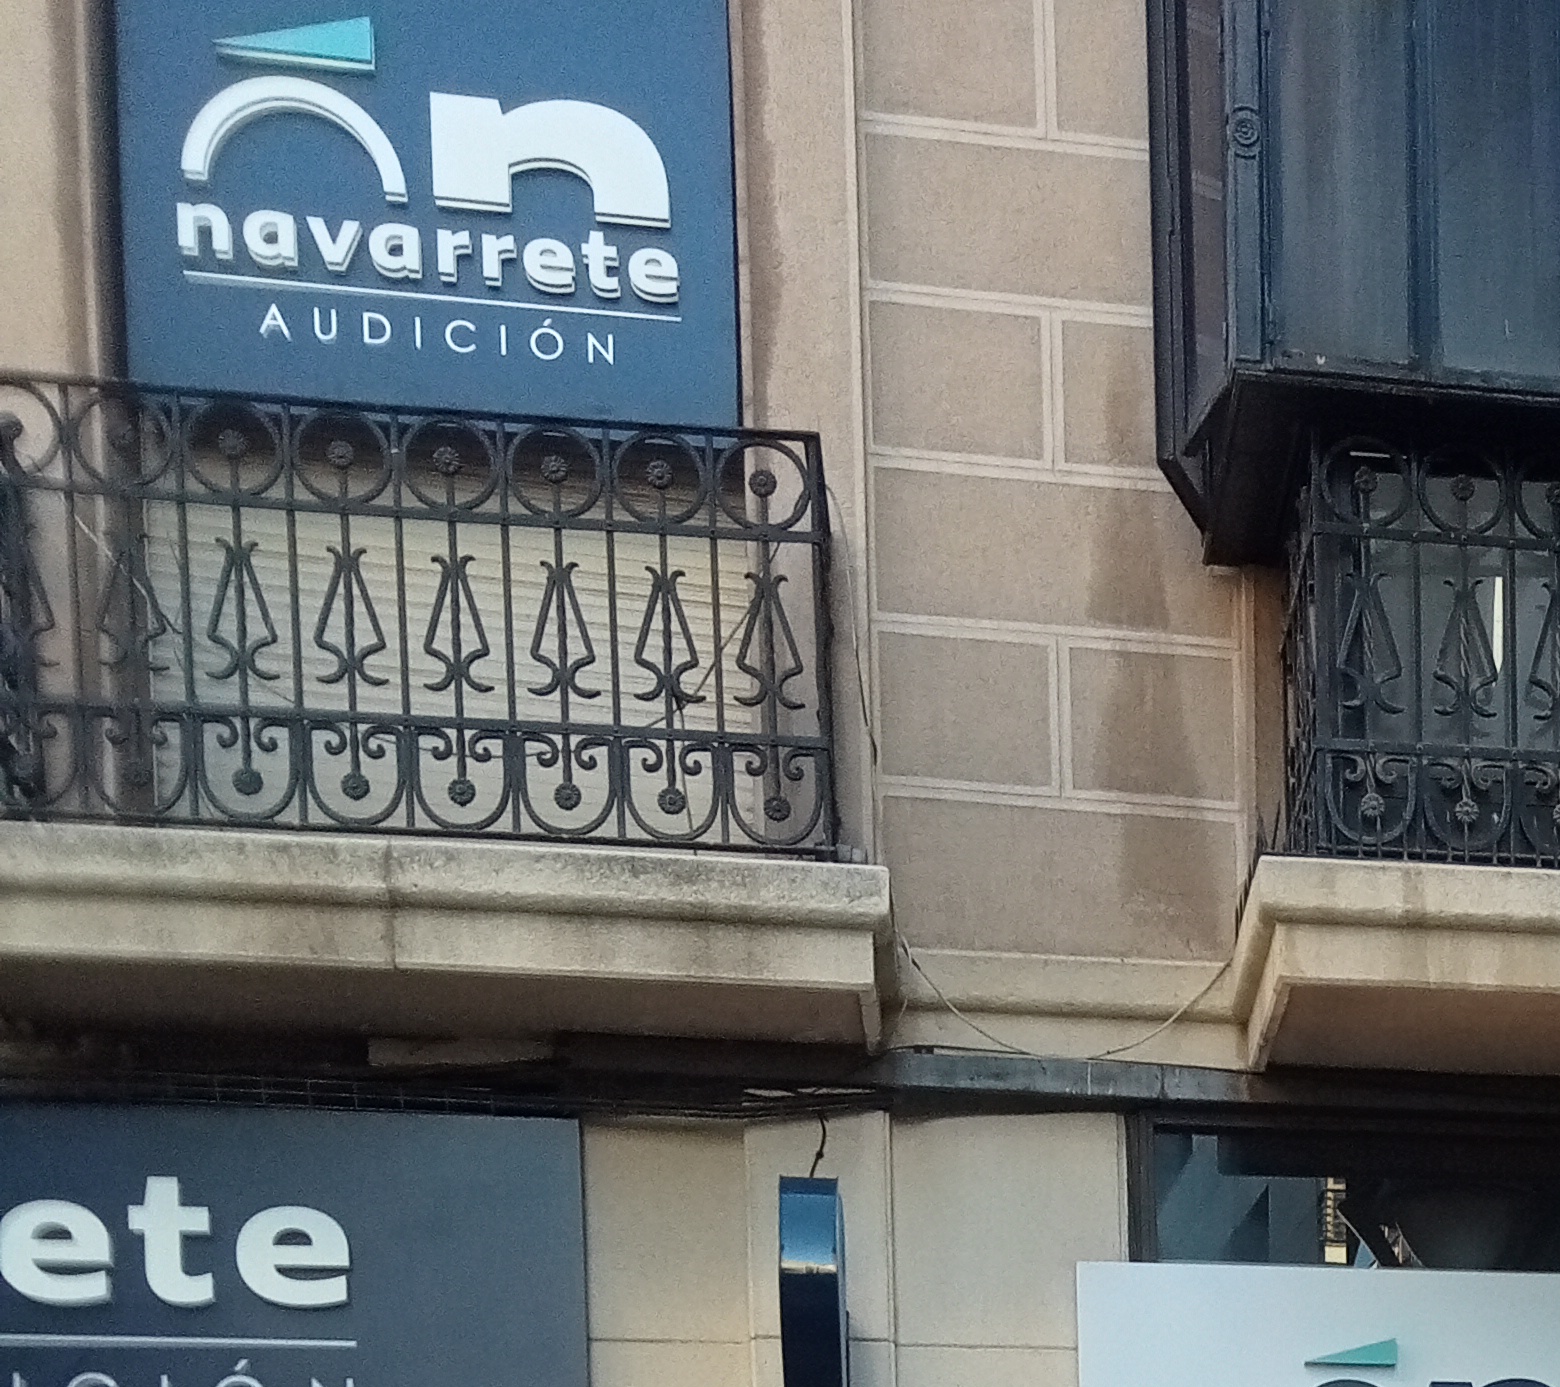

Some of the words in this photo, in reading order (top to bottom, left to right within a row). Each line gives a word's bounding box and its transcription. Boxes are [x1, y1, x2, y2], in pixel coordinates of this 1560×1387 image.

[176, 201, 681, 303] navarrete
[258, 302, 615, 366] AUDICIÓN
[0, 1175, 352, 1309] ete
